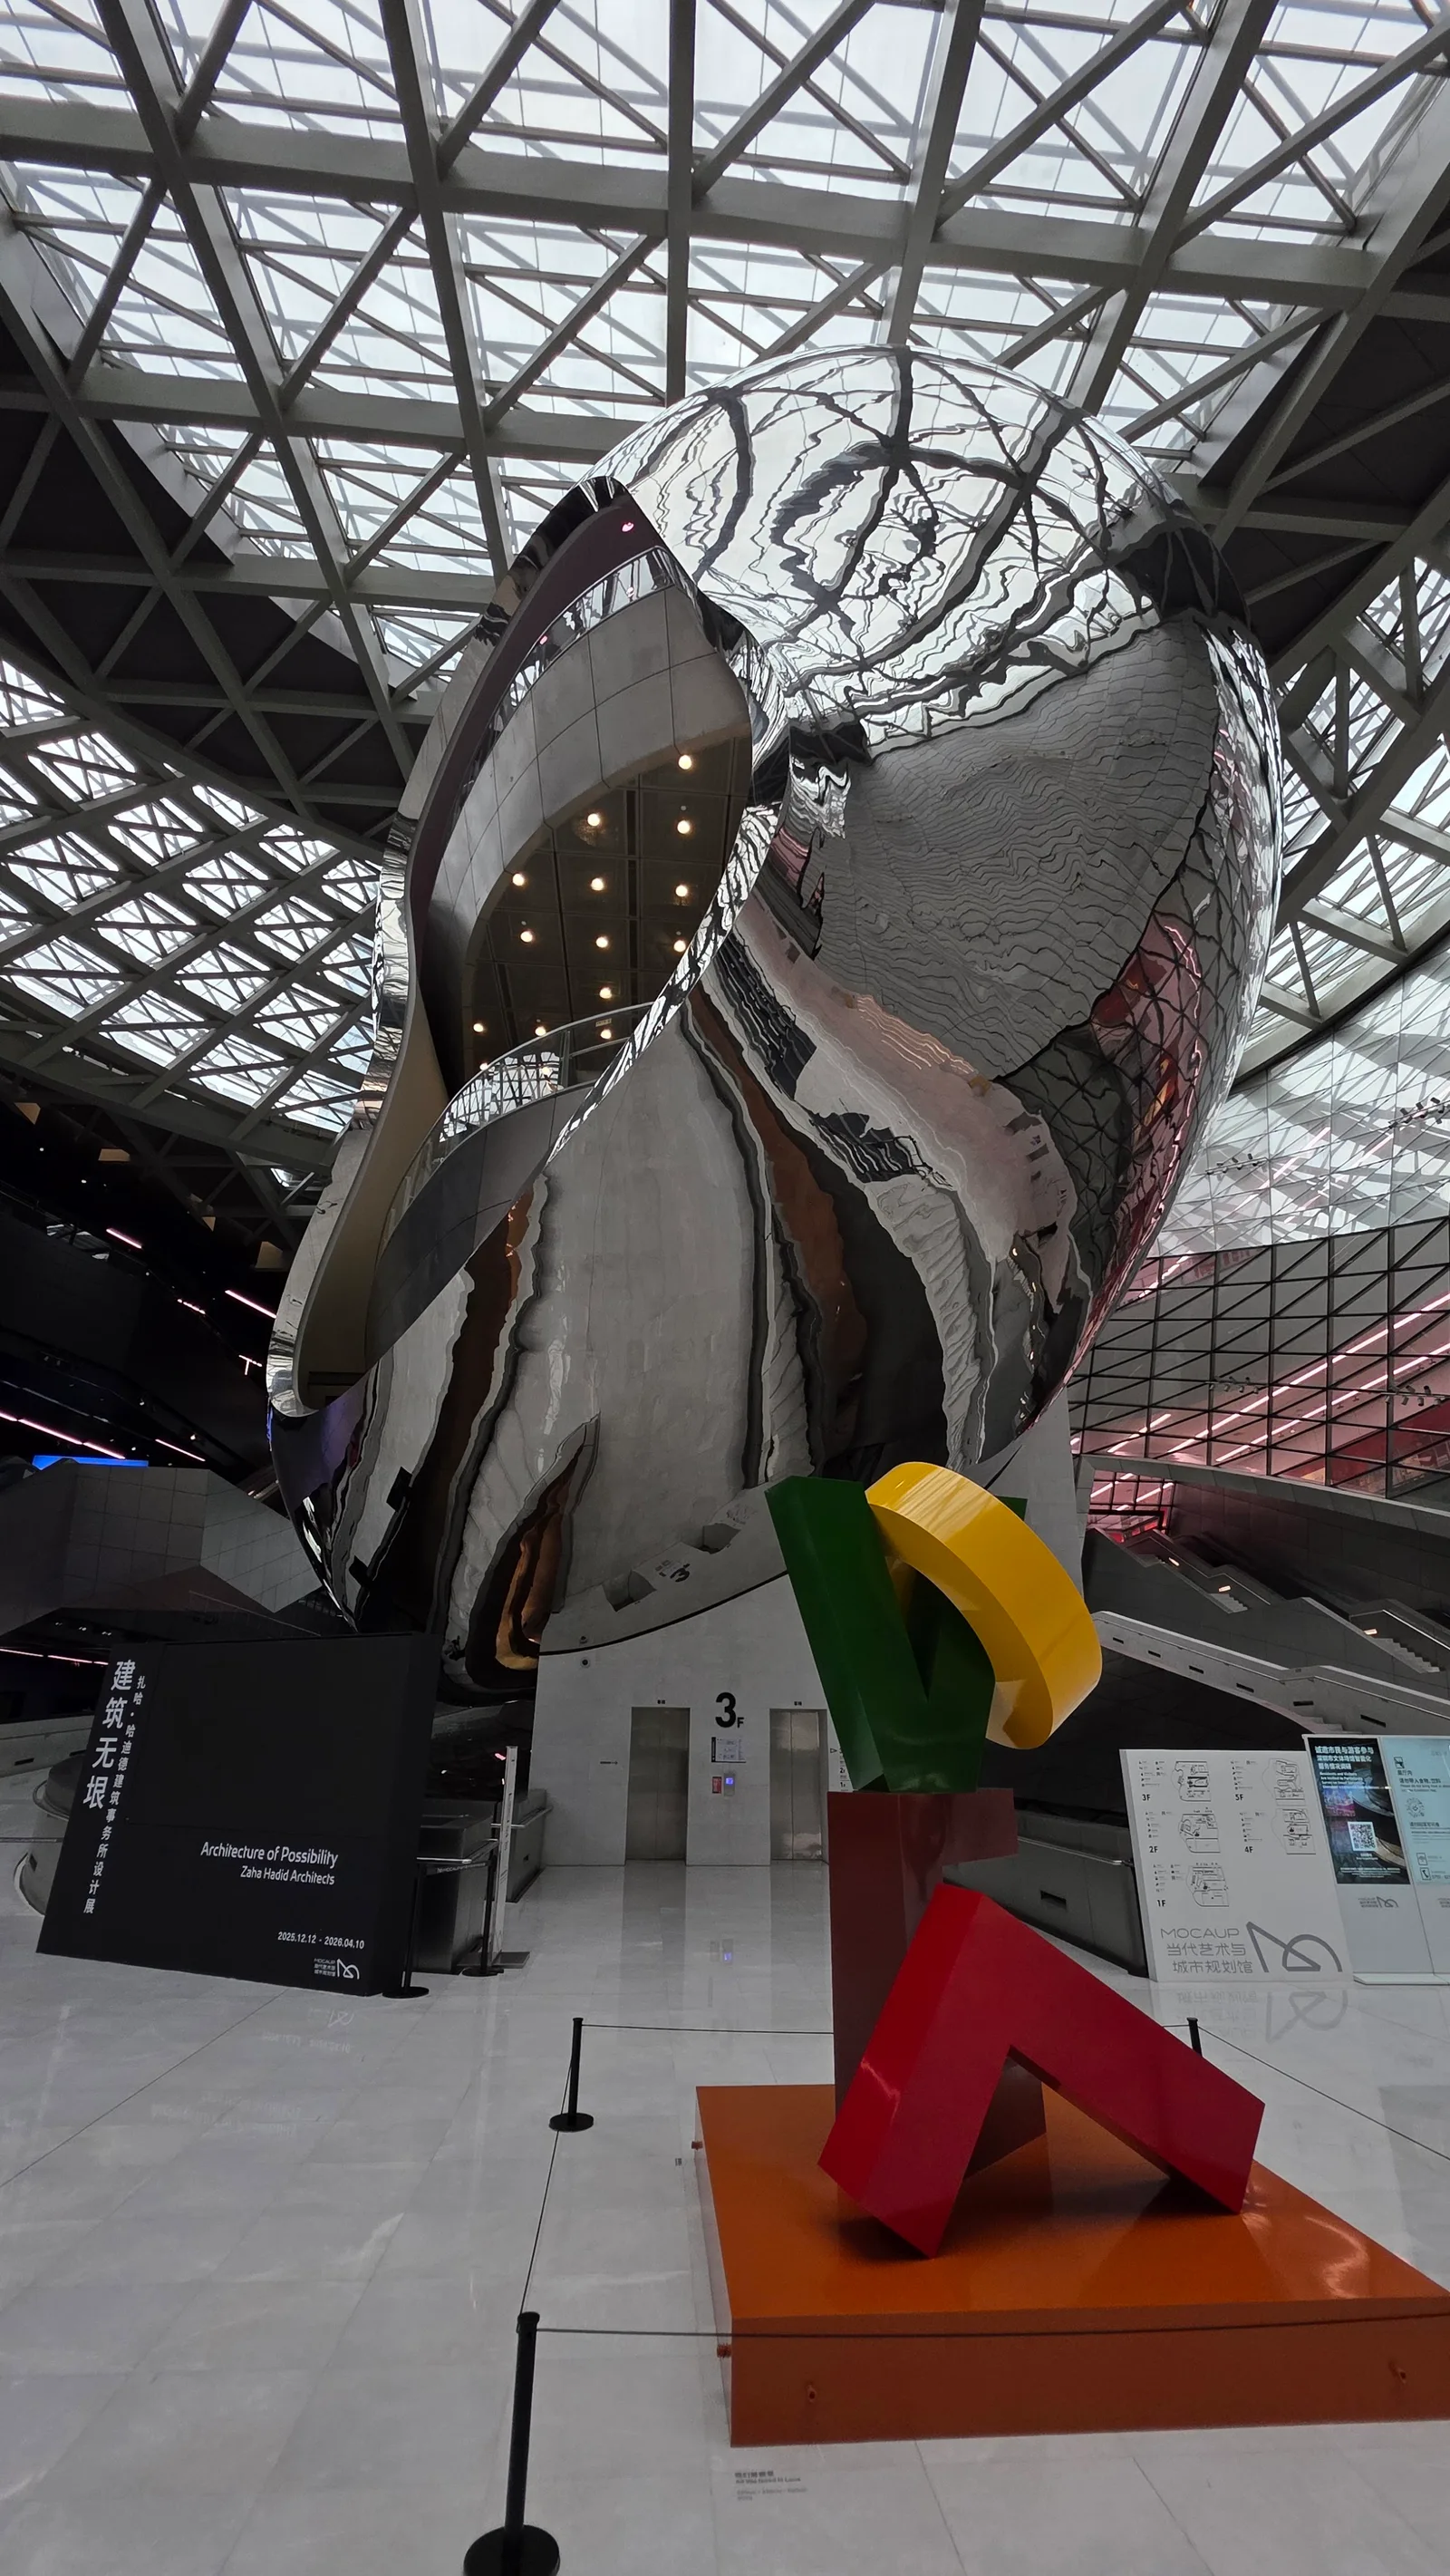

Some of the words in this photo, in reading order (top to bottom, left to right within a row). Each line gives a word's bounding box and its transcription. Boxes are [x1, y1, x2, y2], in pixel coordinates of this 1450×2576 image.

[83, 1659, 136, 1809] 建筑无垠
[83, 1675, 146, 1914] 扎哈·哈迪德建筑事务所设计展
[200, 1841, 265, 1860] Architecture
[266, 1845, 280, 1862] of
[280, 1846, 339, 1869] Possibility
[1148, 1845, 1158, 1854] 2F
[1244, 1845, 1253, 1854] 4F
[240, 1865, 262, 1879] Zaha
[263, 1867, 289, 1882] Hadid
[289, 1869, 335, 1885] Architects
[1156, 1899, 1166, 1907] 1F
[277, 1931, 317, 1944] 2025.12.12
[324, 1935, 365, 1950] 2026.04.10
[1160, 1927, 1240, 1939] MOCAUP
[1166, 1942, 1246, 1957] 当代艺术与
[1172, 1960, 1253, 1974] 城市规划馆
